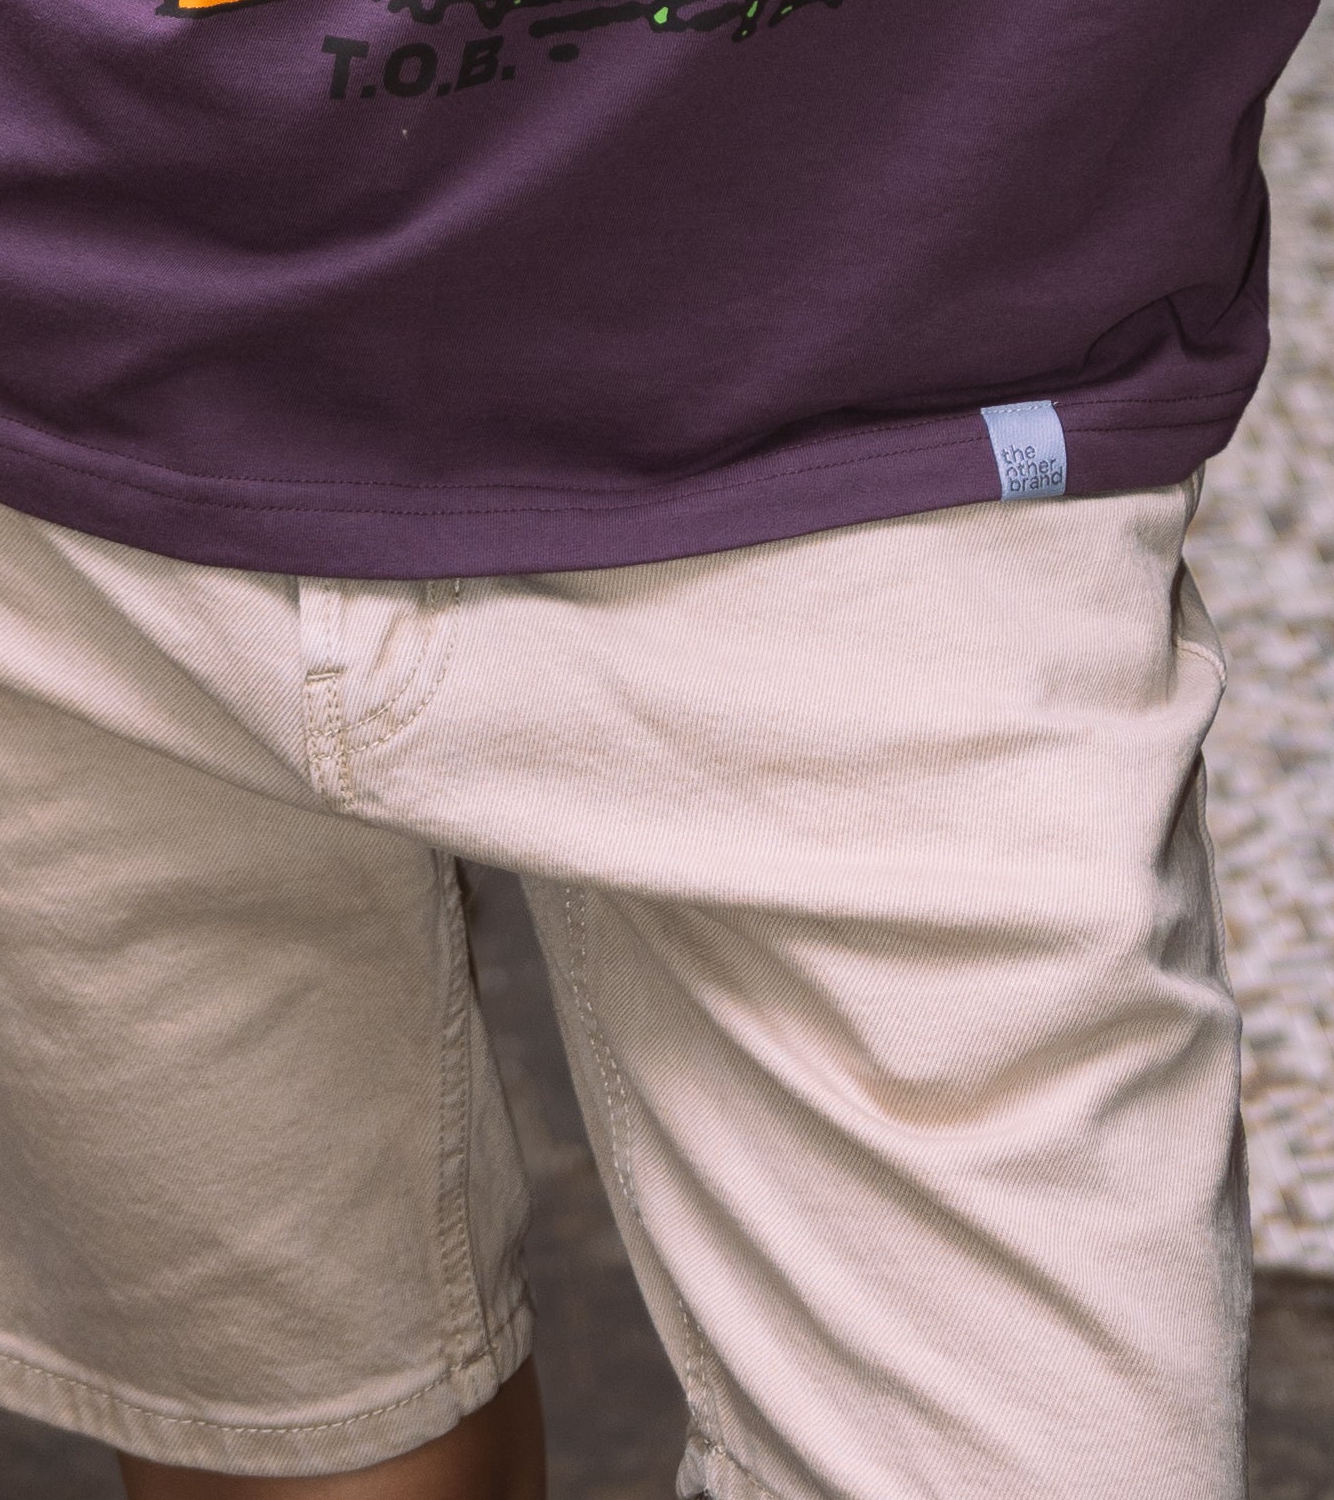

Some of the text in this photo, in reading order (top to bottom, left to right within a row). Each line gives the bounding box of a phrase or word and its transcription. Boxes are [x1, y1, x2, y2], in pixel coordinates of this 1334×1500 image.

[320, 35, 516, 100] T.O.B.
[1002, 444, 1036, 464] the
[1006, 458, 1057, 477] other
[1010, 466, 1063, 492] brand
